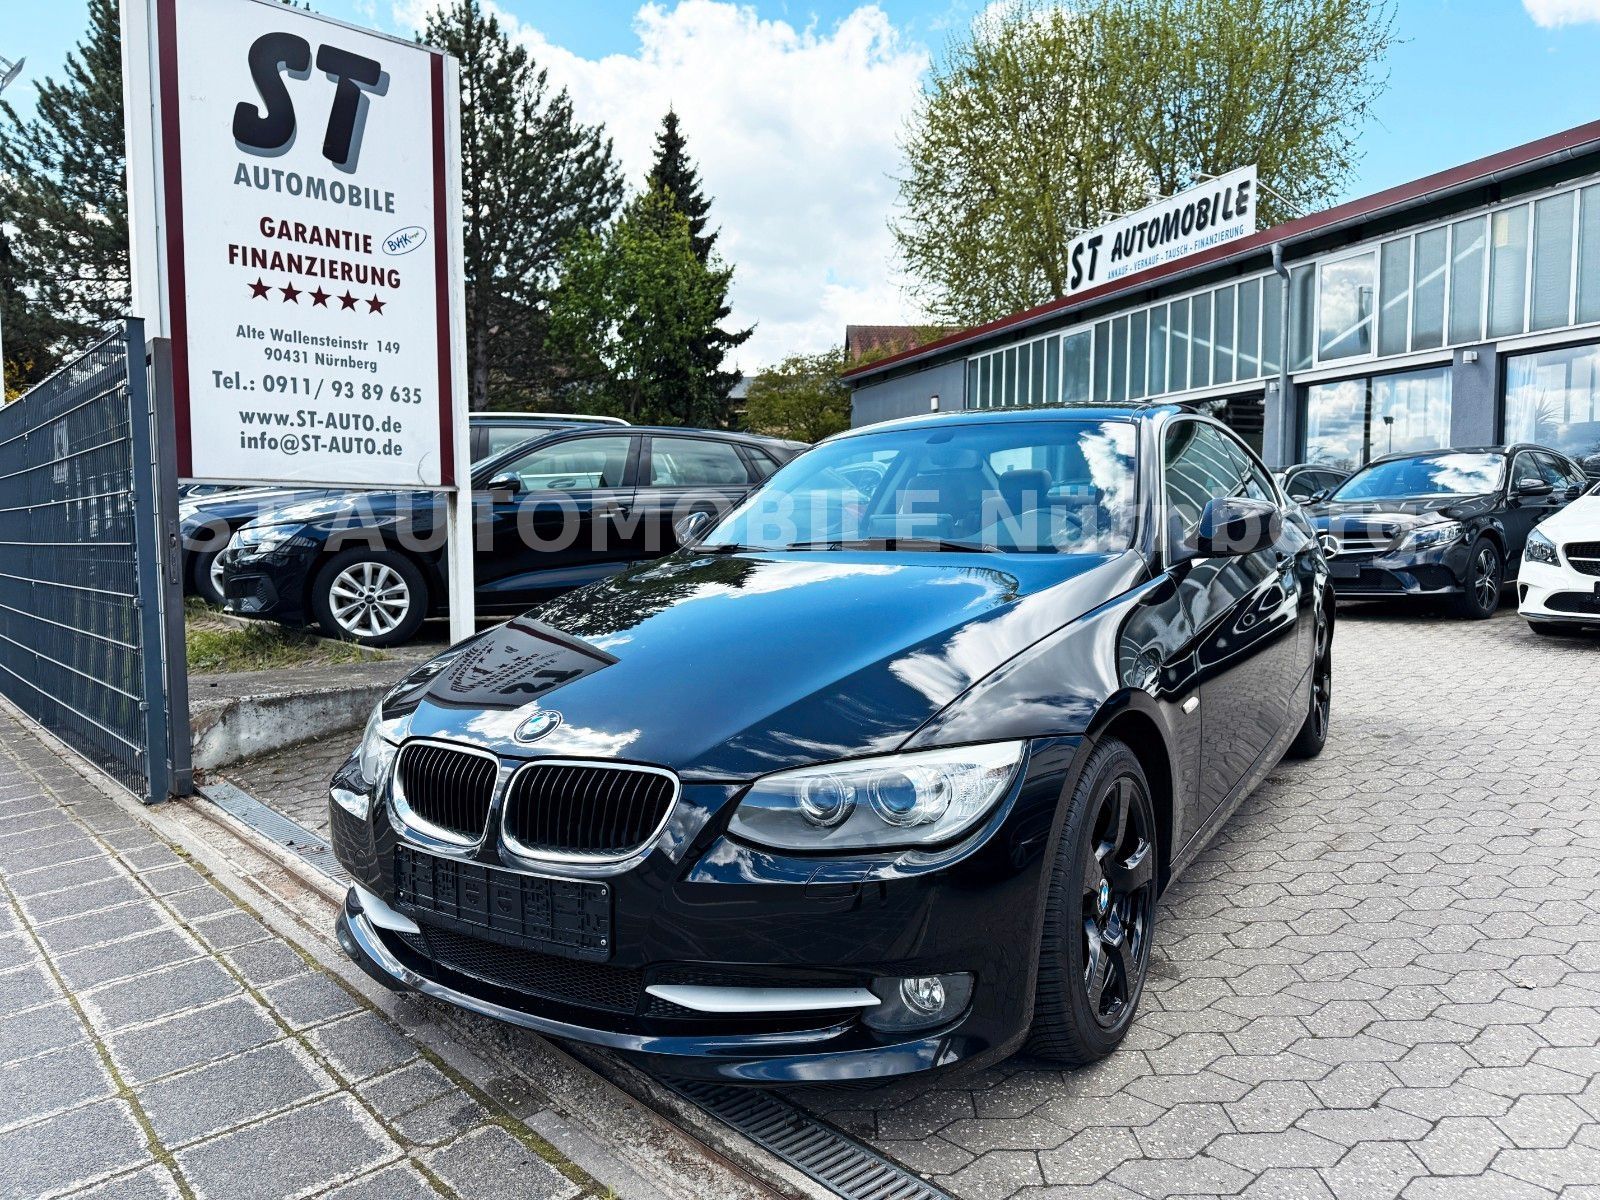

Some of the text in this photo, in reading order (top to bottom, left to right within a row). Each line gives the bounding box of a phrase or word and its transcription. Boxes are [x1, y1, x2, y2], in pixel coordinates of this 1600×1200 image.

[232, 32, 390, 174] ST
[234, 163, 395, 214] AUTOMOBILE
[259, 216, 373, 254] GARANTIE
[1071, 180, 1250, 290] ST AUTOMOBILE
[1107, 267, 1129, 280] ANKAUF
[1134, 254, 1160, 271] VERKAUF
[1165, 246, 1188, 260] TAUSCH
[1194, 225, 1245, 250] FINANZIERUNG
[228, 243, 401, 289] FINANZIERUNG
[236, 325, 400, 354] Alte Wallensteinstr 149
[264, 347, 378, 373] 90431 Nürnberg
[212, 370, 422, 404] Tel.: 0911/ 93 89 635
[239, 410, 402, 433] www.ST-AUTO.de
[240, 431, 403, 456] info@ST-AUTO.de
